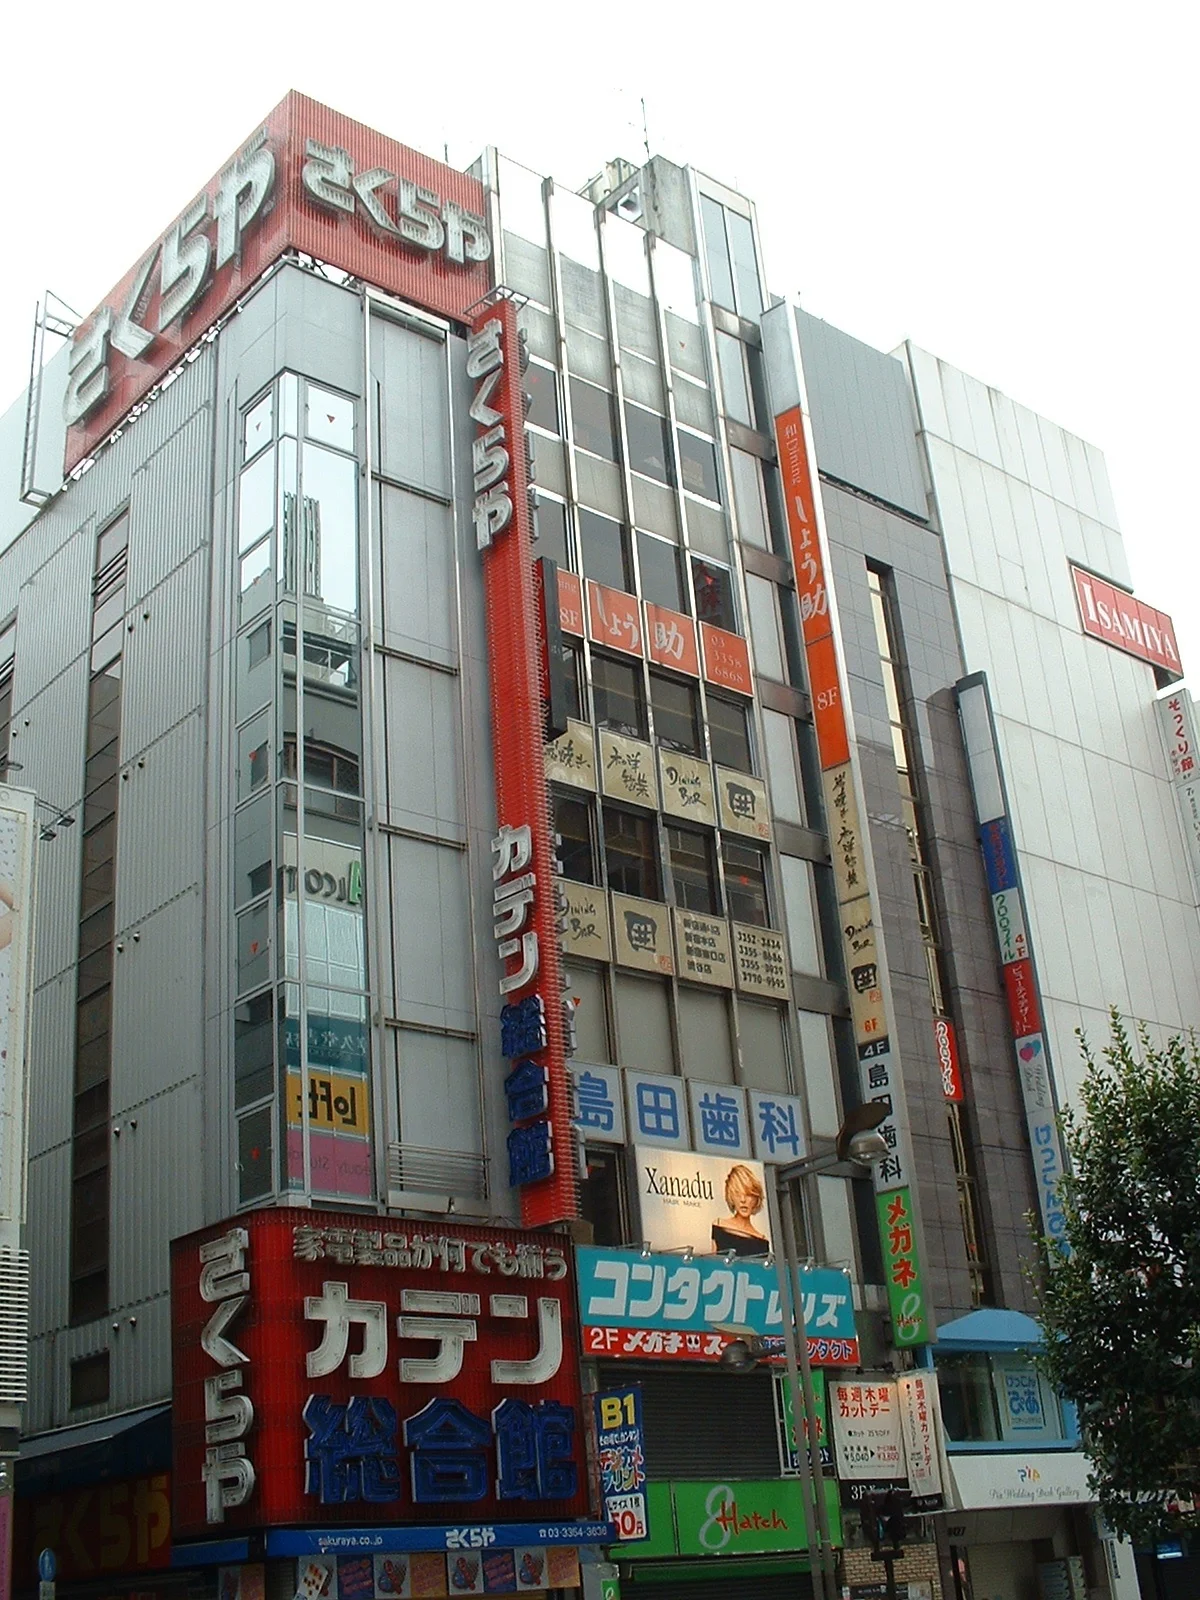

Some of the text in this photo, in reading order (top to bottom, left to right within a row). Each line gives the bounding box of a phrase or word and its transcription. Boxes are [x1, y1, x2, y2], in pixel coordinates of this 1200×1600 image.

[302, 137, 491, 265] さくらや
[64, 128, 277, 427] さくらや
[466, 319, 512, 551] さくらや
[795, 495, 828, 622] しょう助
[560, 607, 579, 628] 8F
[595, 586, 685, 661] しょう助
[1081, 581, 1178, 663] ISAMIYA
[711, 635, 726, 648] 03
[816, 686, 839, 711] 8F
[1167, 698, 1195, 773] そっくり館
[864, 1018, 878, 1034] 6F
[863, 1040, 888, 1059] 4F
[577, 1070, 800, 1157] 島田歯科
[645, 1166, 714, 1200] Xanadu
[662, 1197, 702, 1208] HAIR MAKE
[292, 1224, 568, 1282] 家電製品が何でも揃う
[887, 1195, 918, 1290] メガネ
[303, 1280, 563, 1385] カデン
[590, 1327, 620, 1350] 2F
[199, 1227, 256, 1524] さくらや
[600, 1393, 636, 1430] B1
[837, 1386, 889, 1403] 毎週木曜
[839, 1402, 891, 1418] カットデー
[302, 1393, 579, 1504] 総合館
[1003, 1488, 1036, 1502] Wedding
[1054, 1486, 1080, 1500] Gallery
[445, 1526, 497, 1548] さくらや
[715, 1501, 789, 1536] Hatch
